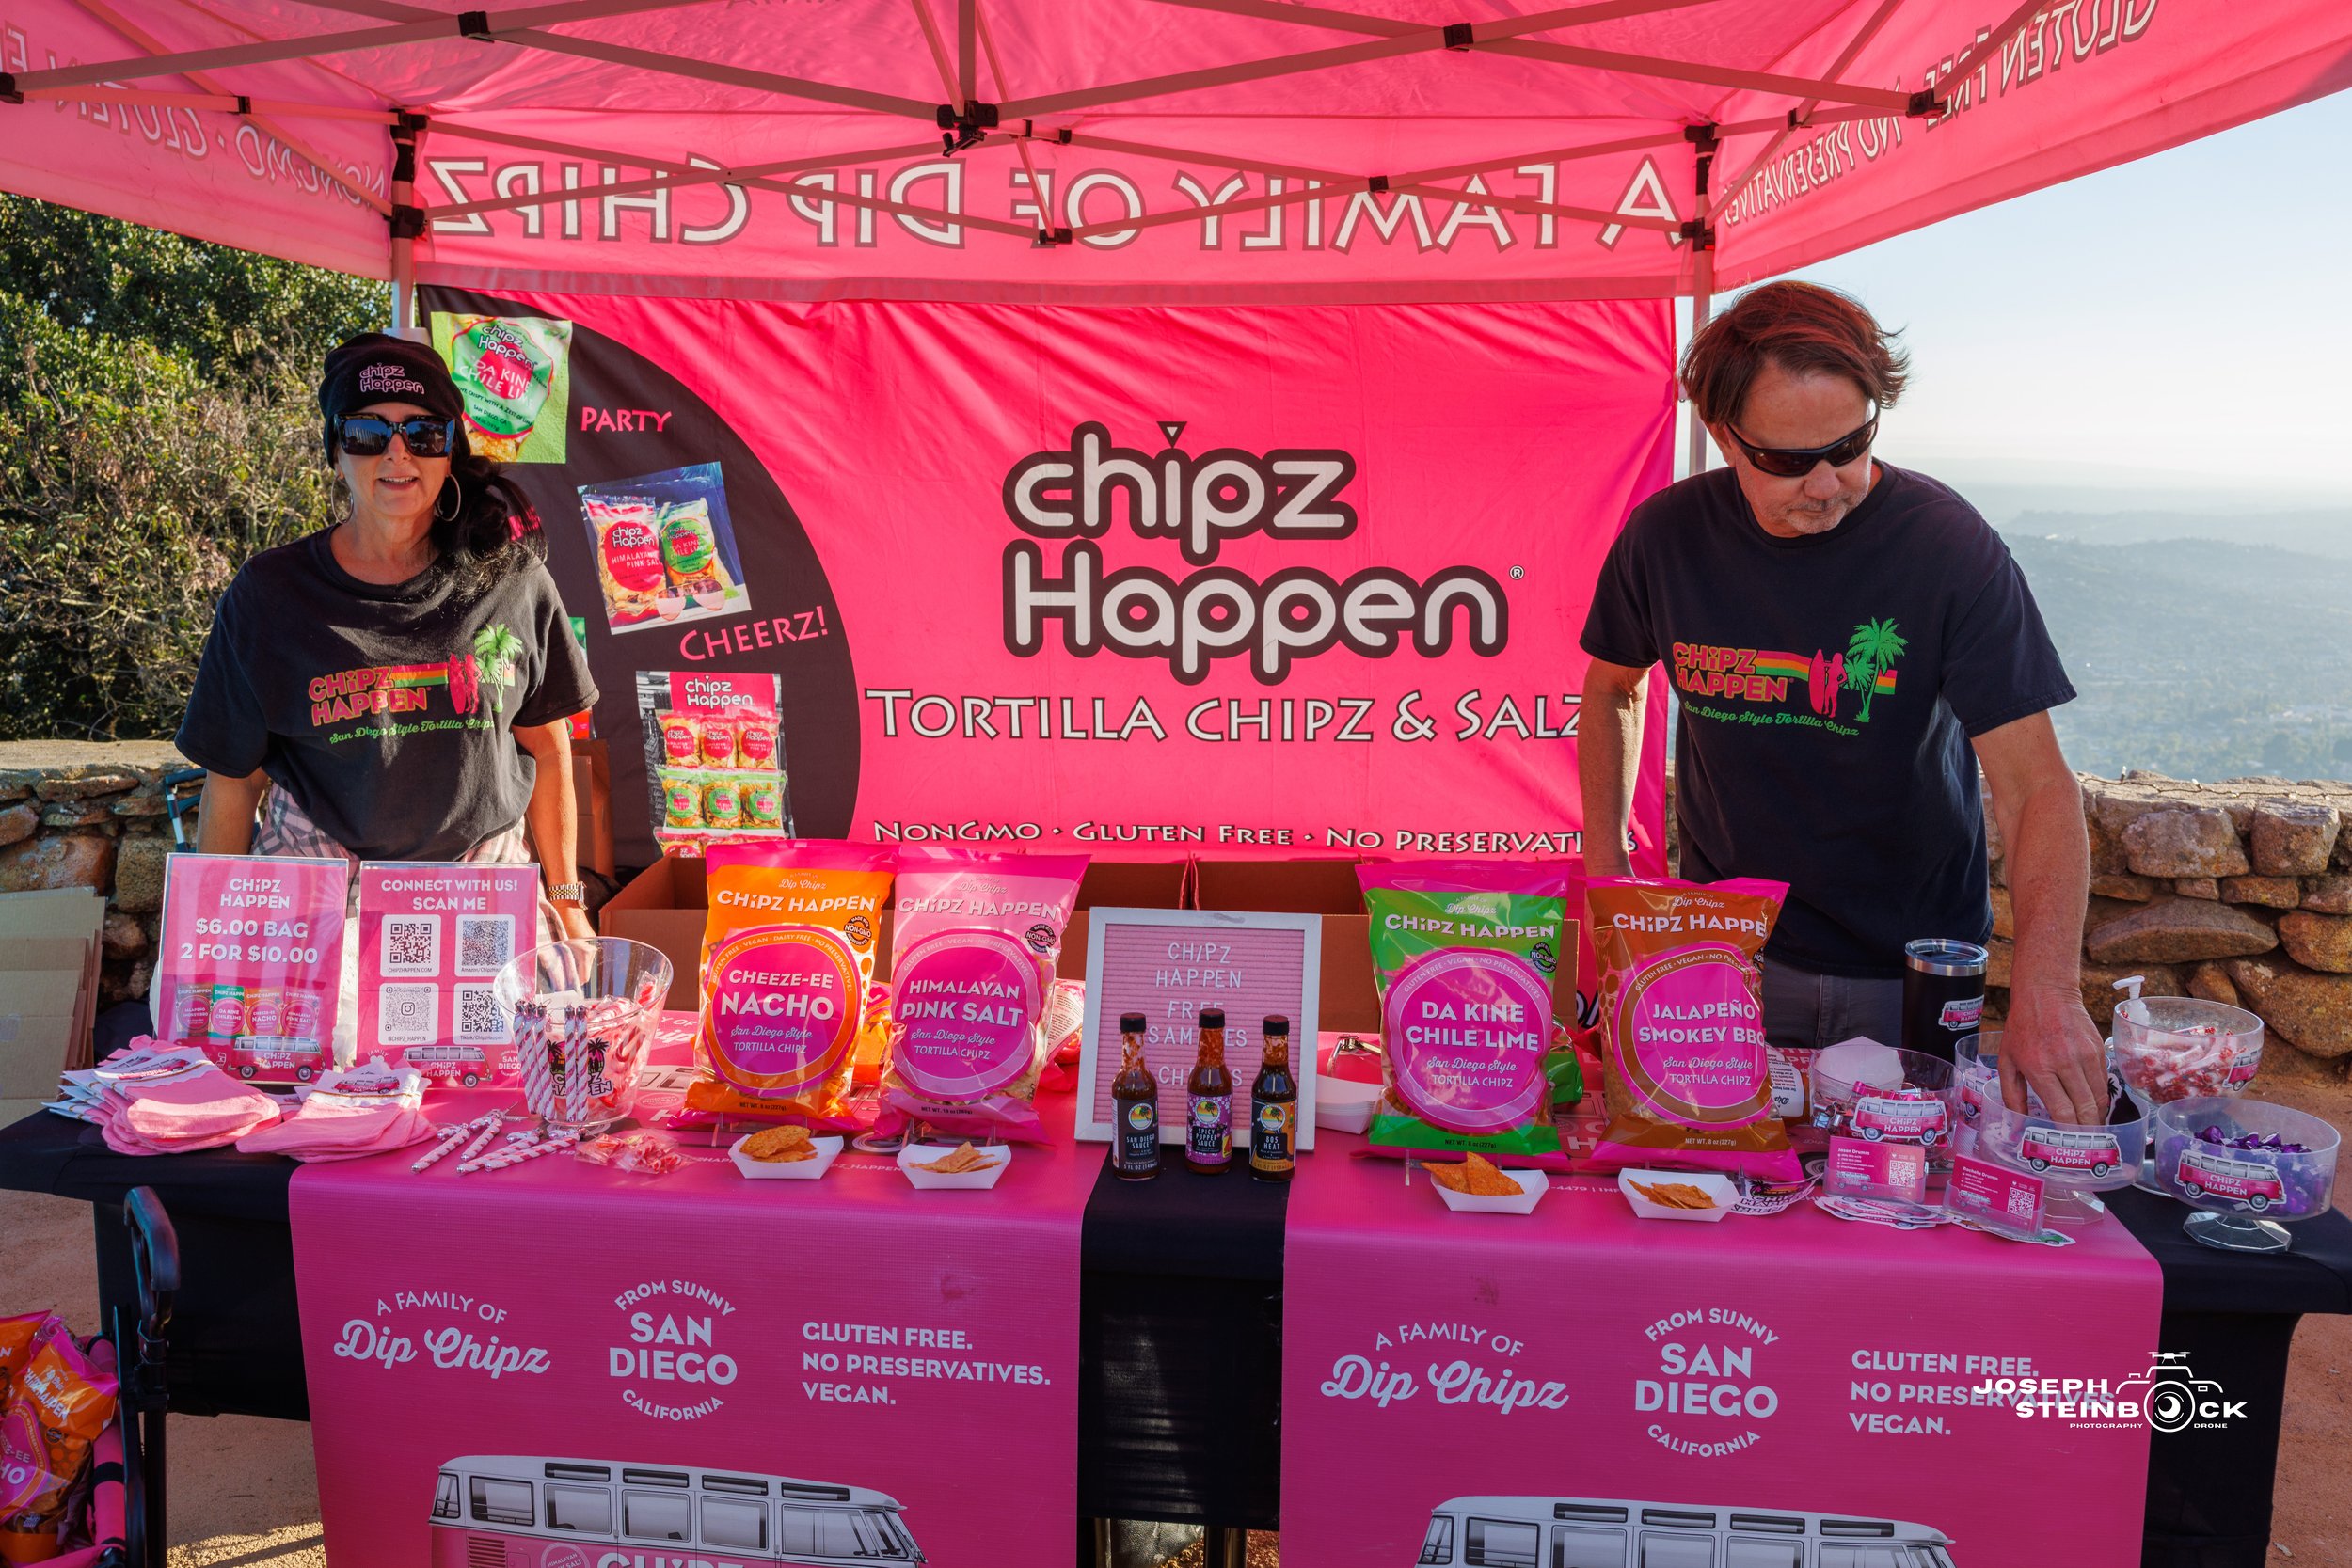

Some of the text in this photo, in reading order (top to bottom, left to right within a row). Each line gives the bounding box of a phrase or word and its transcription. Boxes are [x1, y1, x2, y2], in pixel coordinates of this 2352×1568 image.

[359, 362, 405, 379] chipz
[359, 377, 425, 395] Happen
[580, 406, 672, 433] PARTY
[1002, 420, 1358, 566] chipz
[1002, 538, 1508, 686] Happen
[679, 606, 828, 661] CHEERZ!
[684, 675, 732, 695] chipz
[1674, 663, 1788, 703] HAPPEN
[310, 687, 427, 727] HAPPEN
[686, 694, 753, 709] Happen
[865, 688, 1166, 742] TORTILLA
[1392, 689, 1437, 742] &
[1701, 706, 1860, 736] Diego Style Tortilla Chipz
[1395, 828, 1637, 853] PRESERVATIS
[381, 879, 518, 893] CONNECT WITH US!
[220, 892, 290, 910] HAPPEN
[412, 895, 486, 911] SCAN ME
[788, 895, 876, 912] HAPPEN
[968, 901, 1058, 921] HAPPEN
[1672, 896, 1725, 909] Dip Chipz
[196, 918, 309, 939] $6.00 BAG
[1460, 923, 1555, 939] HAPPEN
[1689, 914, 1767, 938] HAPPE
[181, 942, 318, 964] 2 FOR $10.00
[743, 937, 769, 947] VEGAN
[729, 969, 834, 989] CHEEZE-EE
[1155, 968, 1242, 989] HAPPEN
[1425, 963, 1443, 975] FREE
[1447, 957, 1473, 965] VEGAN
[1493, 960, 1541, 999] PRESERVATIVES
[909, 979, 1020, 1000] HIMALAYAN
[720, 991, 834, 1021] NACHO
[900, 1001, 1024, 1028] PINK SALT
[1422, 1001, 1524, 1023] DA KINE
[1653, 999, 1756, 1021] JALAPEÑO
[730, 1024, 812, 1040] San Diego Style
[911, 1028, 995, 1045] San Diego Style
[1148, 1026, 1248, 1047] SAMES
[1406, 1025, 1538, 1052] CHILE LIME
[1639, 1026, 1729, 1045] SMOKEY
[733, 1042, 807, 1054] TORTILLA CHIPZ
[914, 1045, 991, 1060] TORTILLA CHIPZ
[1427, 1056, 1518, 1072] San Diego Style
[1663, 1057, 1753, 1070] San Diego Style
[1431, 1074, 1514, 1088] TORTILLA CHIPZ
[1669, 1073, 1752, 1085] TORTILLA CHIPZ
[2050, 1155, 2091, 1165] HAPPEN
[2204, 1180, 2248, 1196] HAPPEN
[375, 1291, 508, 1325] A FAMILY OF
[614, 1279, 738, 1317] FROM SUNNY
[629, 1312, 714, 1347] SAN
[803, 1322, 973, 1351] GLUTEN FREE.
[1644, 1308, 1781, 1347] FROM SUNNY
[333, 1319, 551, 1380] Dip Chipz
[1375, 1323, 1524, 1358] A FAMILY OF
[609, 1347, 738, 1386] DIEGO
[803, 1352, 1052, 1386] NO PRESERVATIVES.
[1659, 1342, 1752, 1378] SAN
[1851, 1349, 2040, 1377] GLUTEN FREE.
[802, 1382, 898, 1405] VEGAN.
[1320, 1354, 1569, 1415] Dip Chipz
[1851, 1382, 1891, 1403] NO
[622, 1388, 723, 1421] CALIFORNIA
[1633, 1379, 1778, 1418] DIEGO
[1850, 1413, 1953, 1436] VEGAN.
[1646, 1424, 1761, 1458] CALIFORNIA
[548, 1552, 578, 1567] HIMALAYAN
